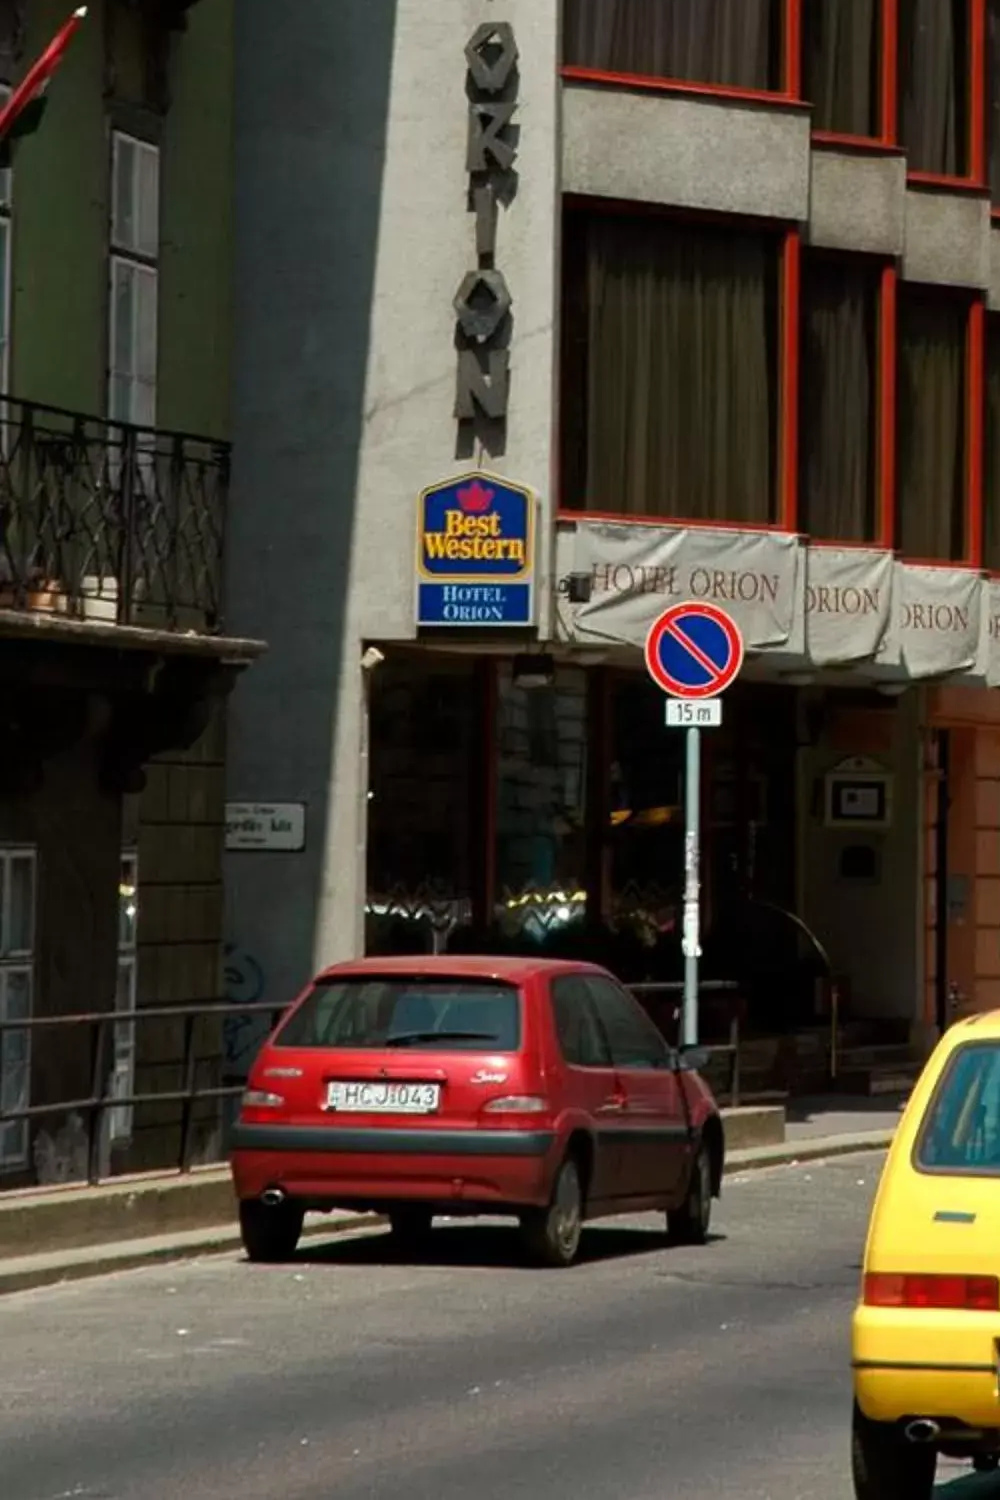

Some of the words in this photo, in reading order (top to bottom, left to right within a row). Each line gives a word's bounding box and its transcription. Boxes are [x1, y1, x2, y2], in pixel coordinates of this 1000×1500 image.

[452, 21, 520, 419] ORION
[445, 509, 502, 537] Best
[424, 532, 525, 566] Western
[590, 562, 681, 596] HOTEL
[689, 567, 780, 603] ORION
[677, 703, 693, 722] 15
[697, 707, 711, 722] m
